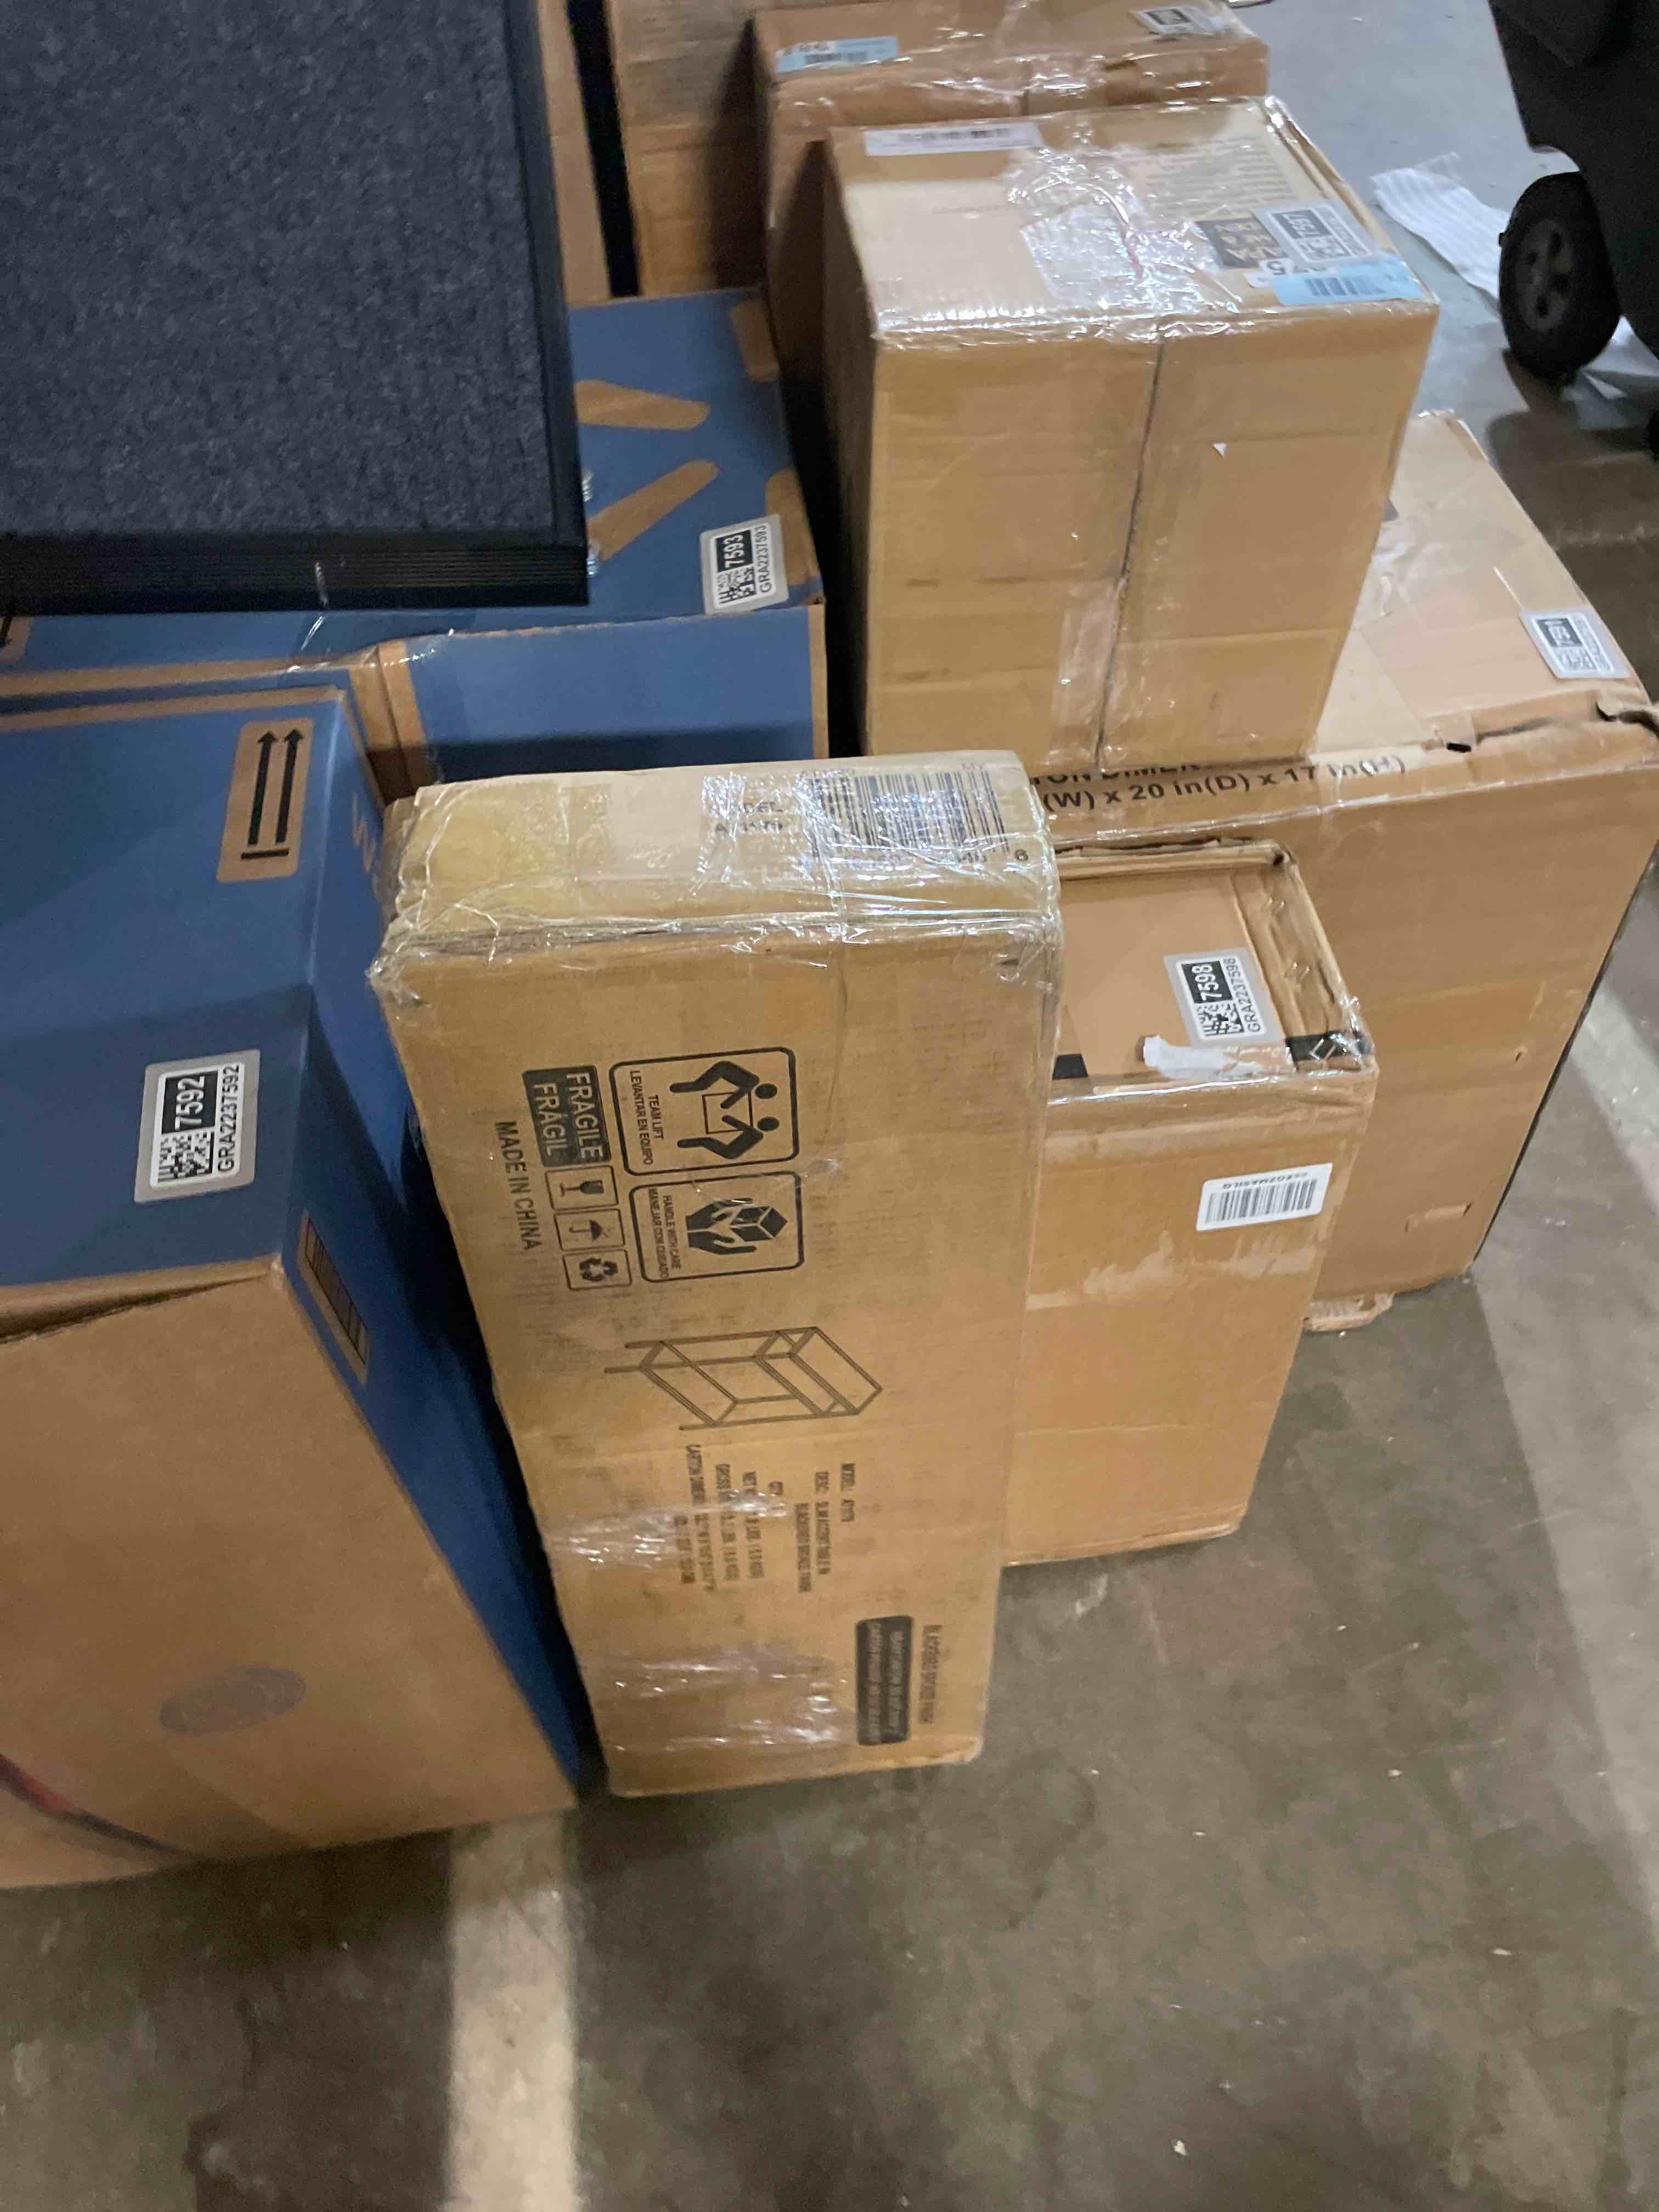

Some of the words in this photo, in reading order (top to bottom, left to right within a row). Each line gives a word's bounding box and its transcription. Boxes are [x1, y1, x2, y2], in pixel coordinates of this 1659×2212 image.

[724, 535, 745, 568] 7593
[755, 525, 773, 593] GRA2237593
[1043, 791, 1095, 812] (W)
[1103, 791, 1121, 804] x
[1128, 783, 1165, 800] 20
[1172, 772, 1250, 797] in(D)
[1257, 773, 1277, 786] x
[1284, 765, 1317, 783] 17
[1191, 964, 1223, 1001] 7598
[174, 1075, 205, 1131] 7592
[567, 1072, 603, 1159] FRAGILE
[630, 1070, 646, 1117] LEVANTAR
[648, 1094, 662, 1120] TEAM
[217, 1064, 240, 1172] GRA2237592
[637, 1119, 648, 1131] EN
[652, 1122, 664, 1141] LIFT
[495, 1121, 527, 1173] MADE
[639, 1133, 654, 1165] EQUIPO
[507, 1177, 532, 1194] IN
[514, 1198, 543, 1251] CHINA
